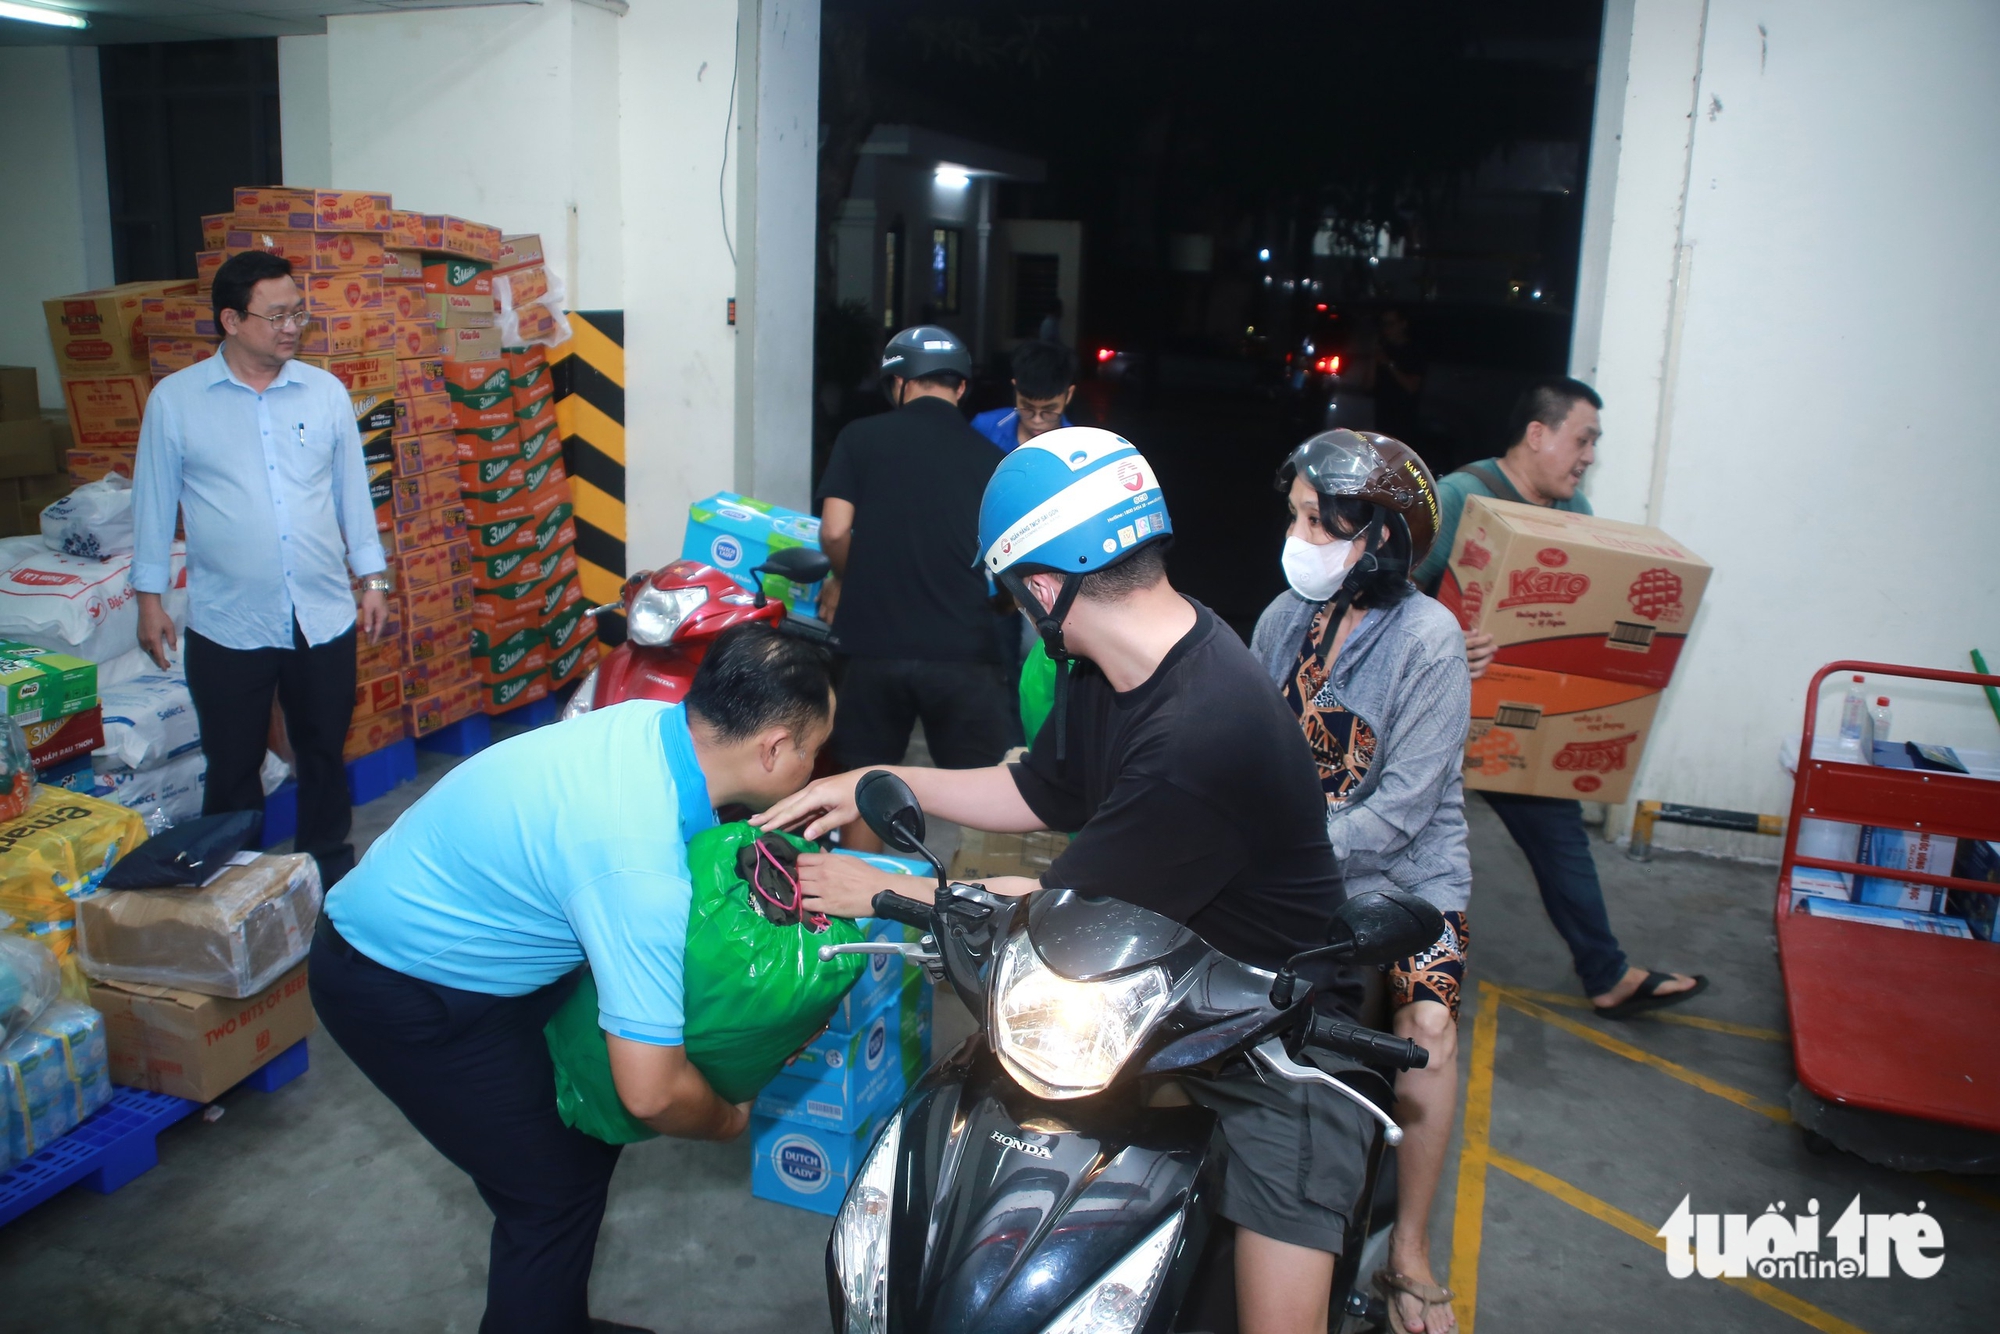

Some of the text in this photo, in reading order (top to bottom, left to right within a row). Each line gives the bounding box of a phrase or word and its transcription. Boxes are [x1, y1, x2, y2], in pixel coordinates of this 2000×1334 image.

[1509, 567, 1591, 598] Karo
[157, 704, 186, 721] Select
[1552, 743, 1627, 774] Karo
[204, 1018, 236, 1047] TWO
[239, 1001, 264, 1027] BITS
[266, 988, 282, 1009] OF
[785, 1150, 818, 1166] DUTCH
[991, 1131, 1053, 1159] HONDA
[789, 1166, 814, 1179] LADY
